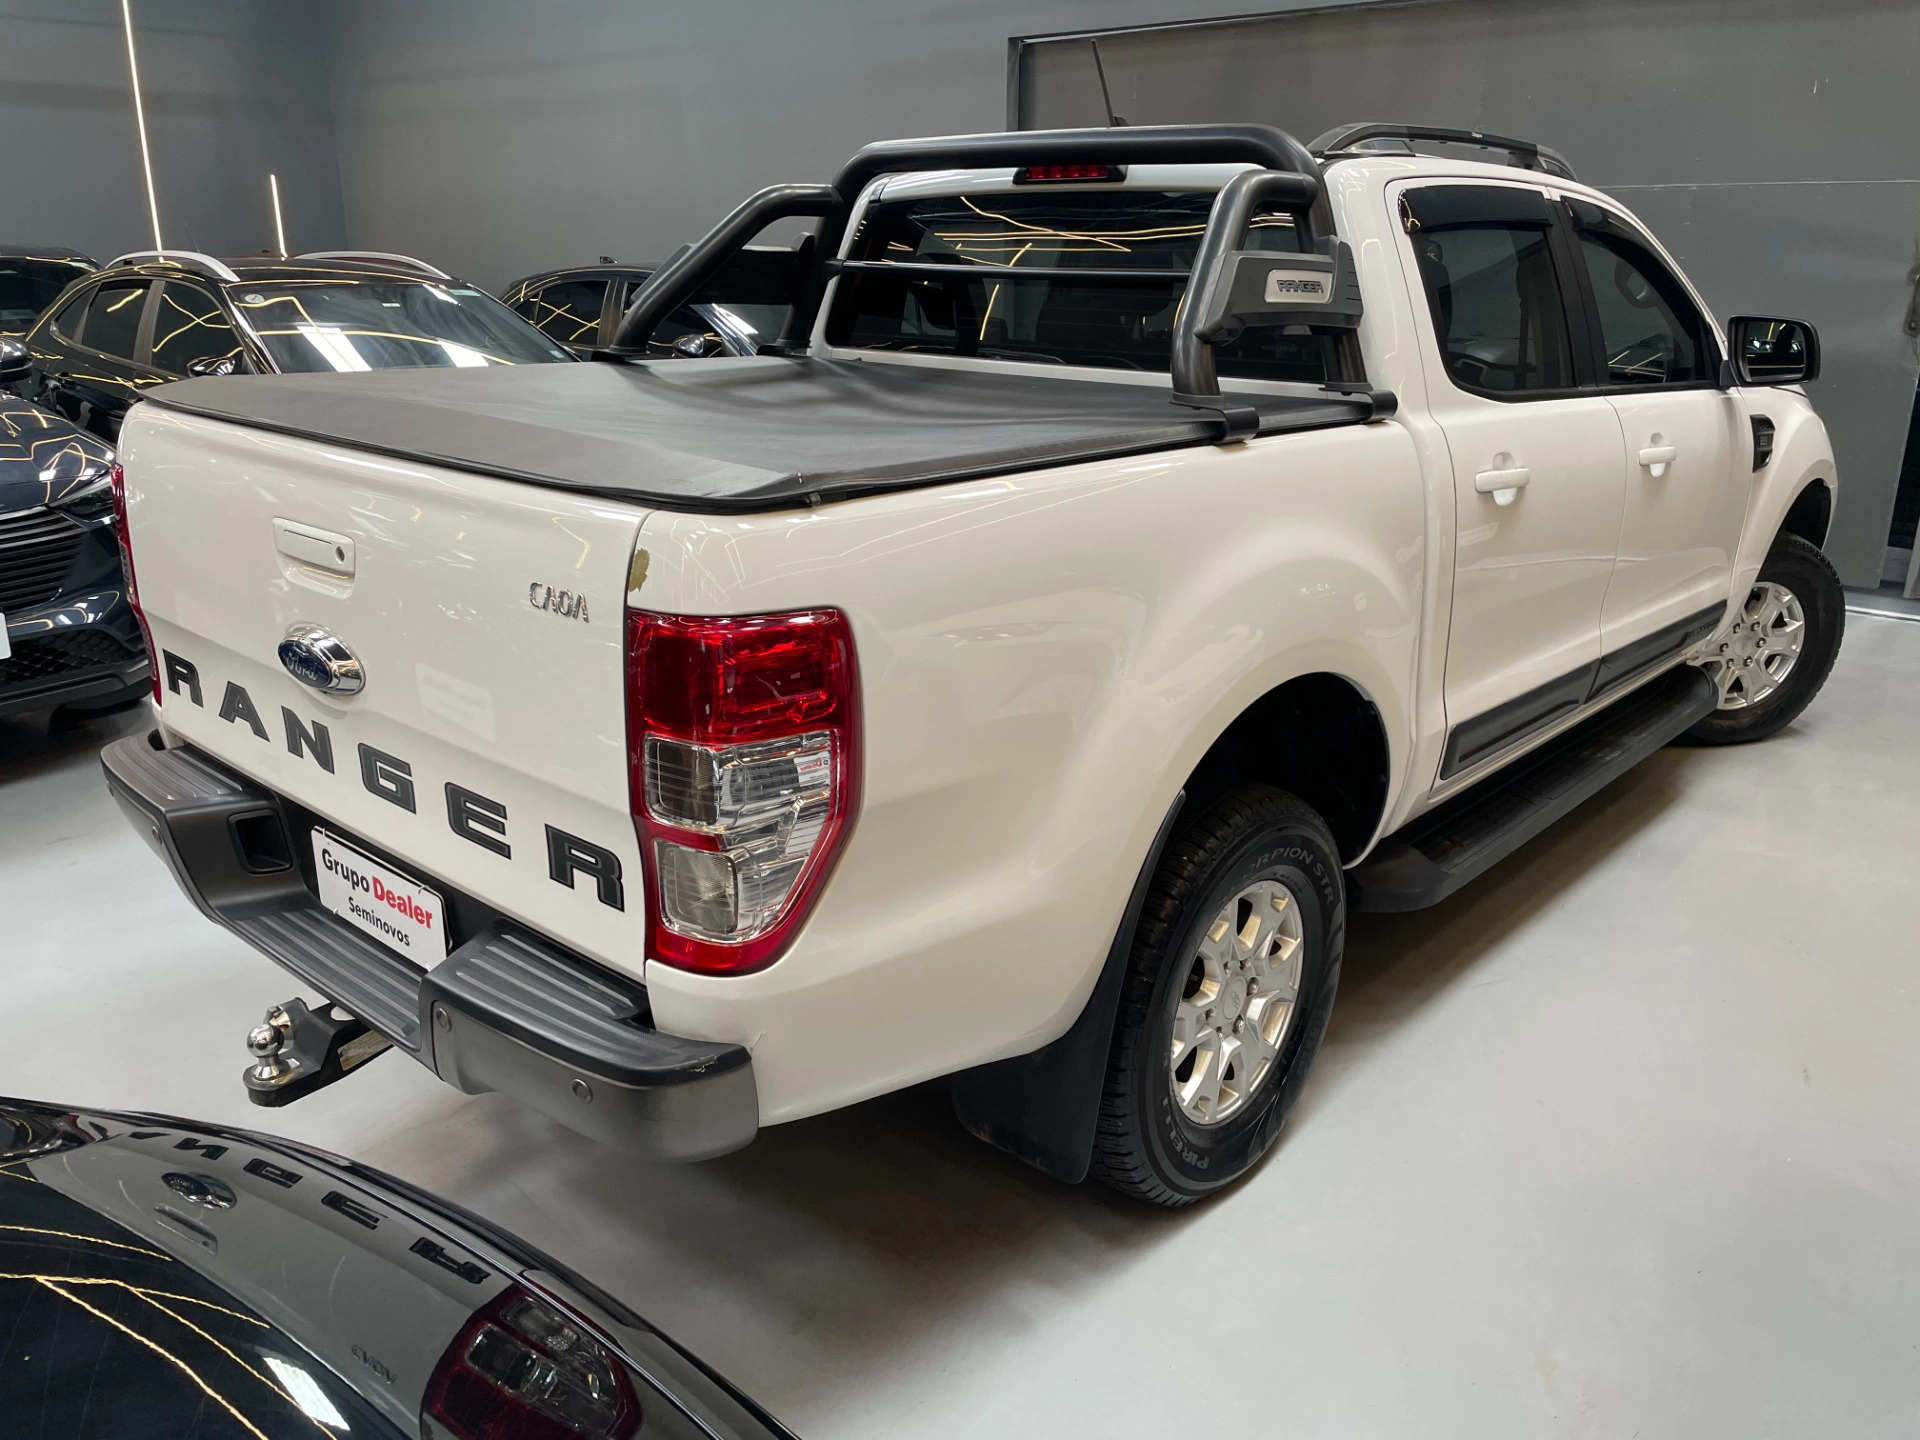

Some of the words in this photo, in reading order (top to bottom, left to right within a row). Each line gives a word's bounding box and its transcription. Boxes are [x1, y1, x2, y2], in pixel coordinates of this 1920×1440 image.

[1276, 280, 1324, 293] RANGER
[529, 581, 589, 623] CAOA
[286, 644, 318, 681] Ford
[162, 648, 625, 913] RANGER
[321, 848, 370, 893] Grupo
[372, 875, 433, 929] Dealer
[1313, 863, 1334, 905] STR
[348, 896, 411, 947] Seminovos
[1163, 1097, 1210, 1170] PIRELLI
